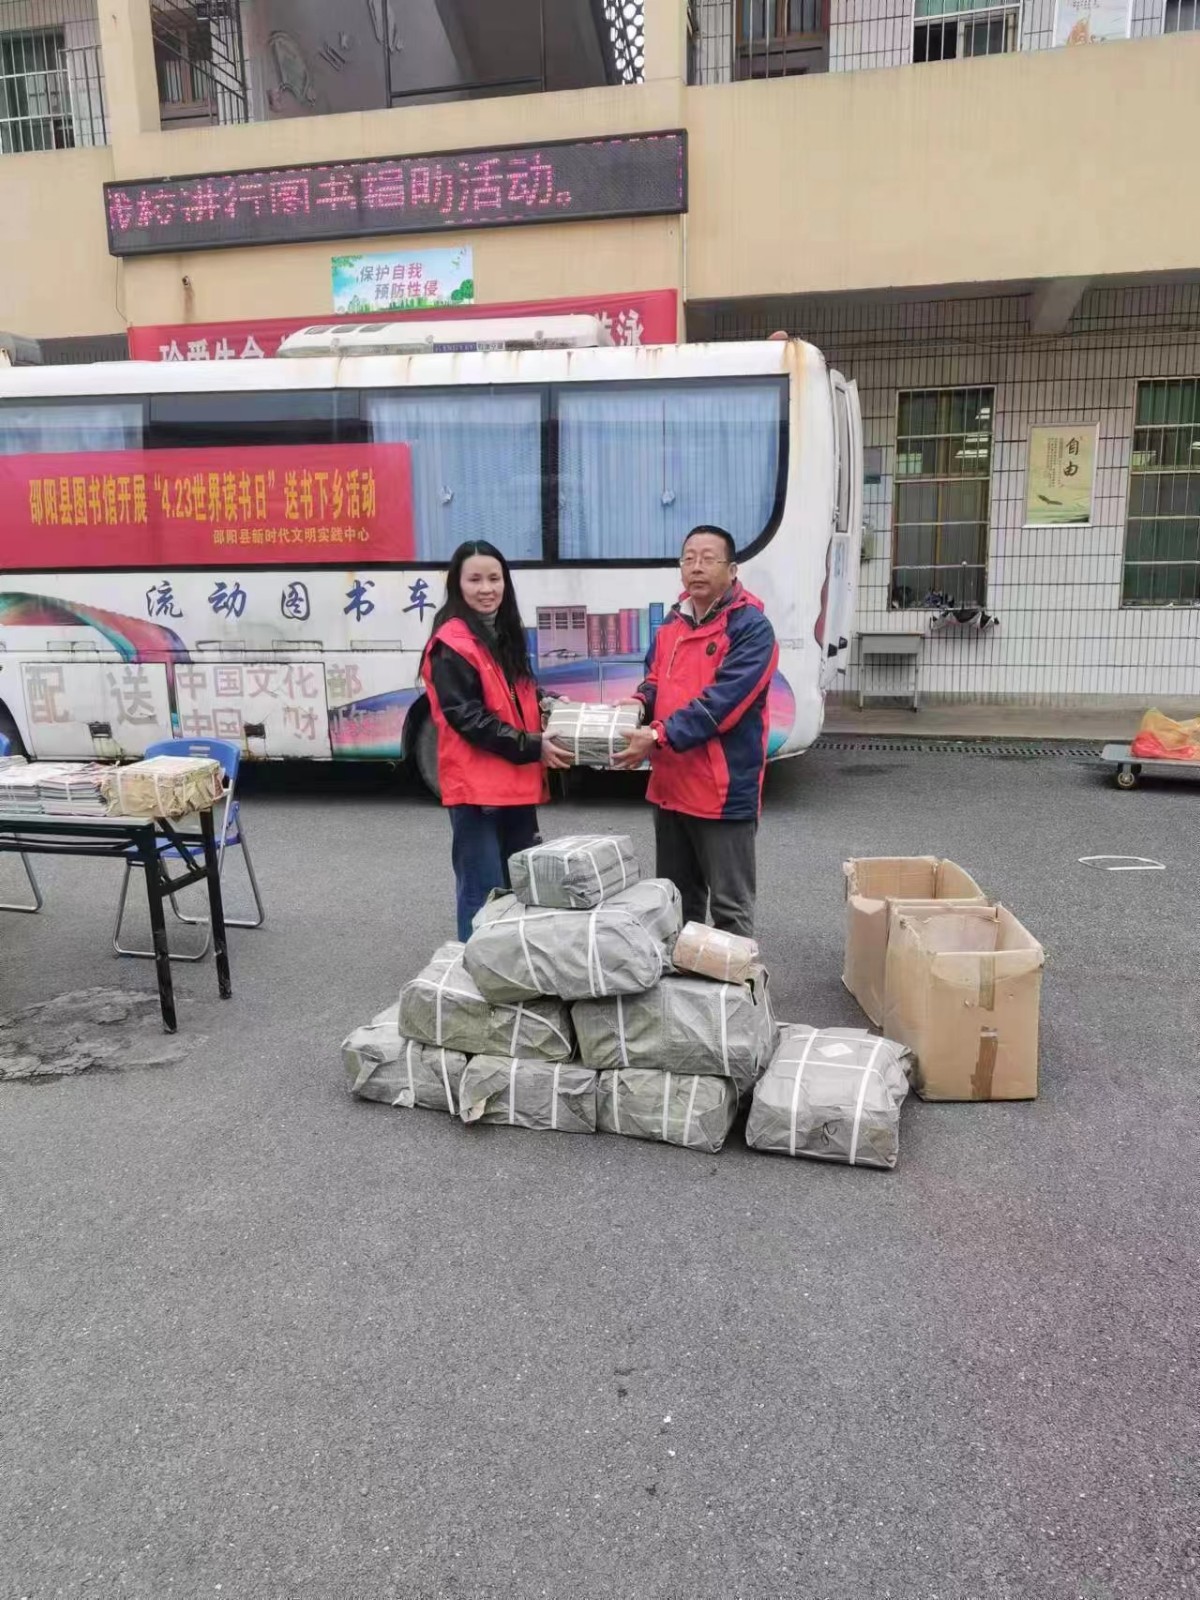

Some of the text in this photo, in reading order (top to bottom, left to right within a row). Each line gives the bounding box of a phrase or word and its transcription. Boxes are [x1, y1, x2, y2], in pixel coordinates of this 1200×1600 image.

[360, 263, 422, 282] 保护自我
[374, 280, 438, 300] 预防性侵
[1064, 437, 1079, 477] 自由
[213, 526, 370, 545] 邵阳县新时代文明实践中心
[146, 579, 436, 621] 流动图书车
[25, 666, 158, 725] 配送
[177, 664, 363, 699] 中国文化部
